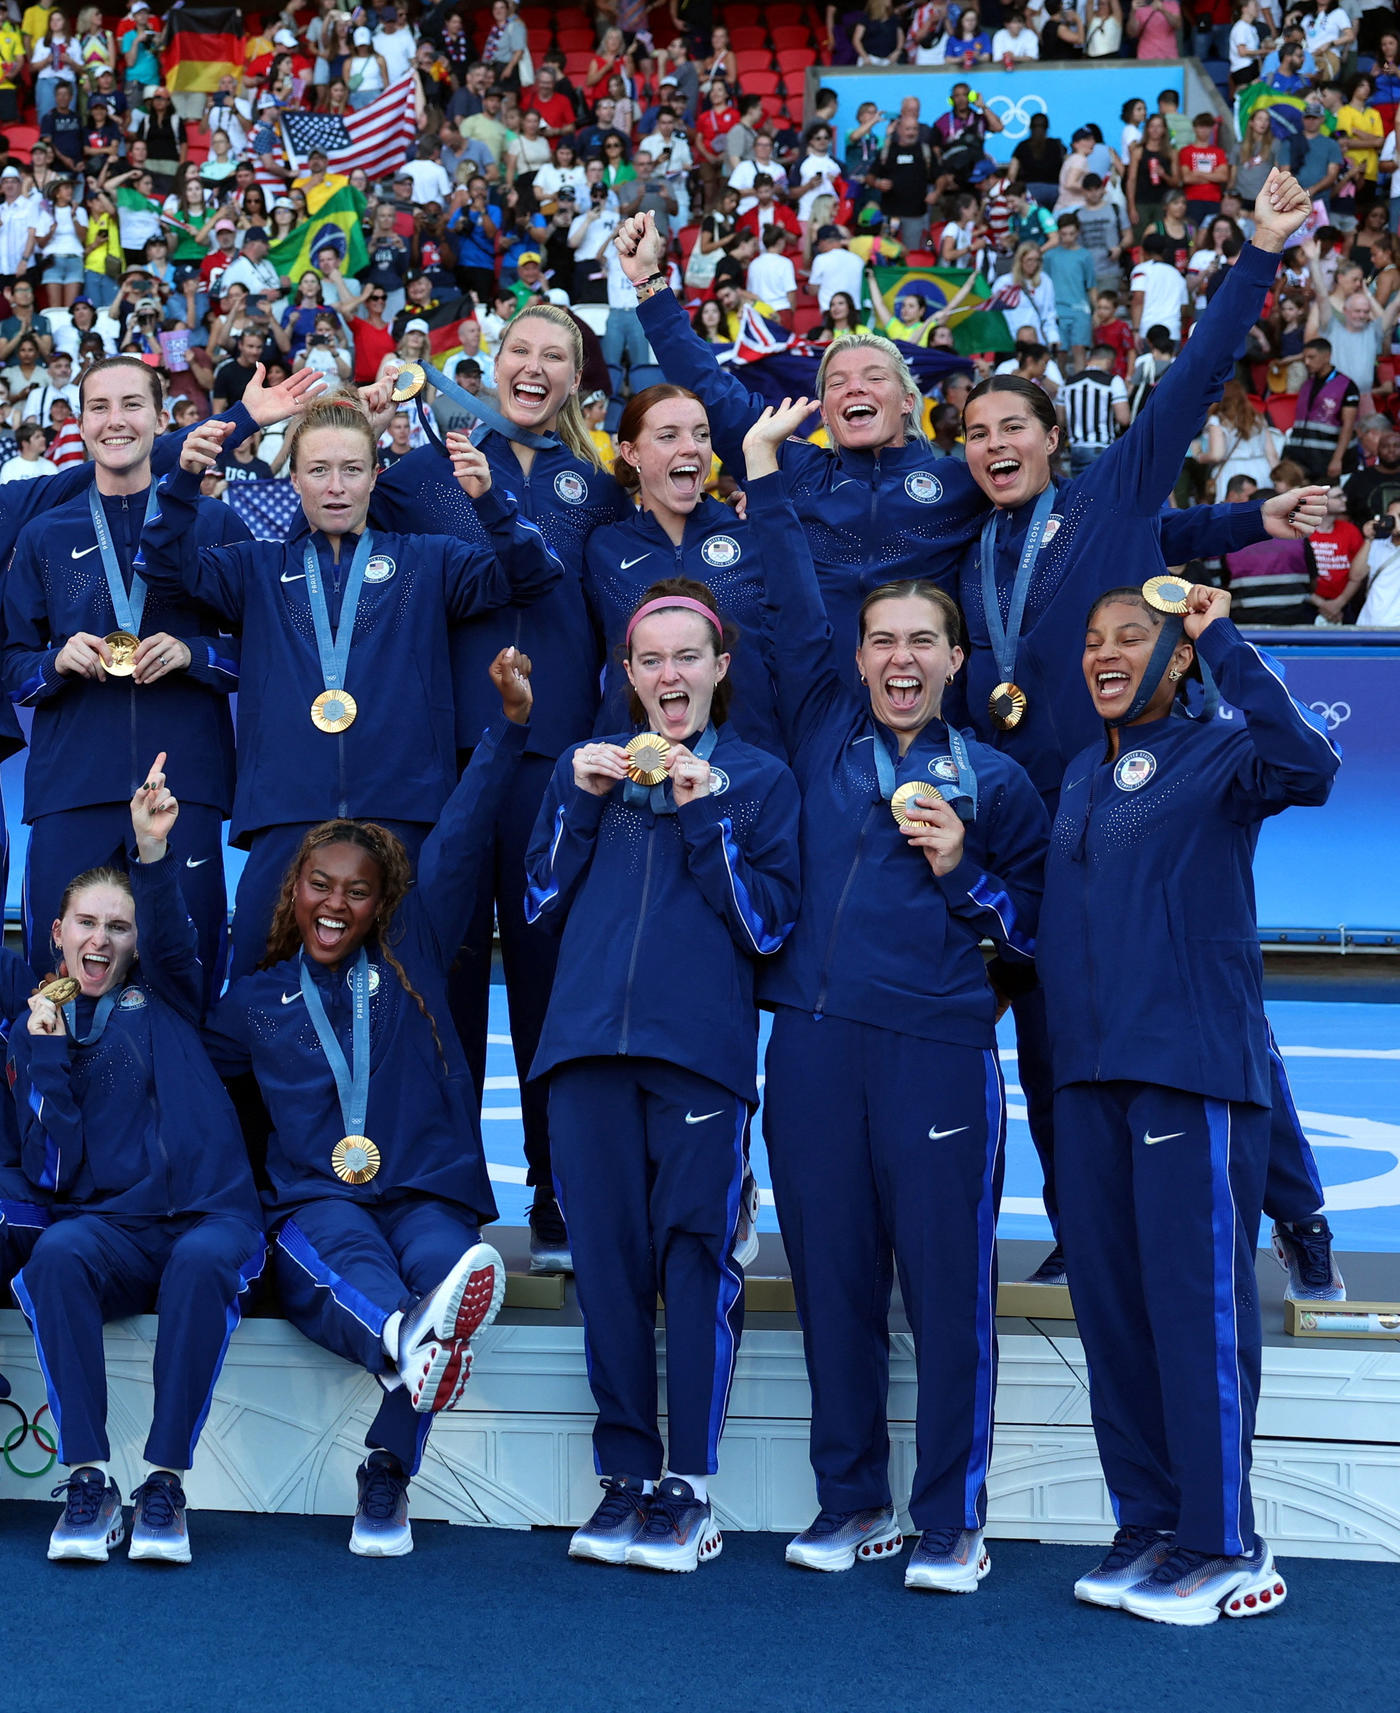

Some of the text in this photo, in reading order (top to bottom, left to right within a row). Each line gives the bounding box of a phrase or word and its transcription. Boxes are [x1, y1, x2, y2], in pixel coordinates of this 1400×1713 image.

[225, 466, 257, 481] USA
[97, 529, 108, 550] PARIS
[1022, 521, 1041, 569] PARIS 2024
[307, 556, 318, 594] PARIS 2024
